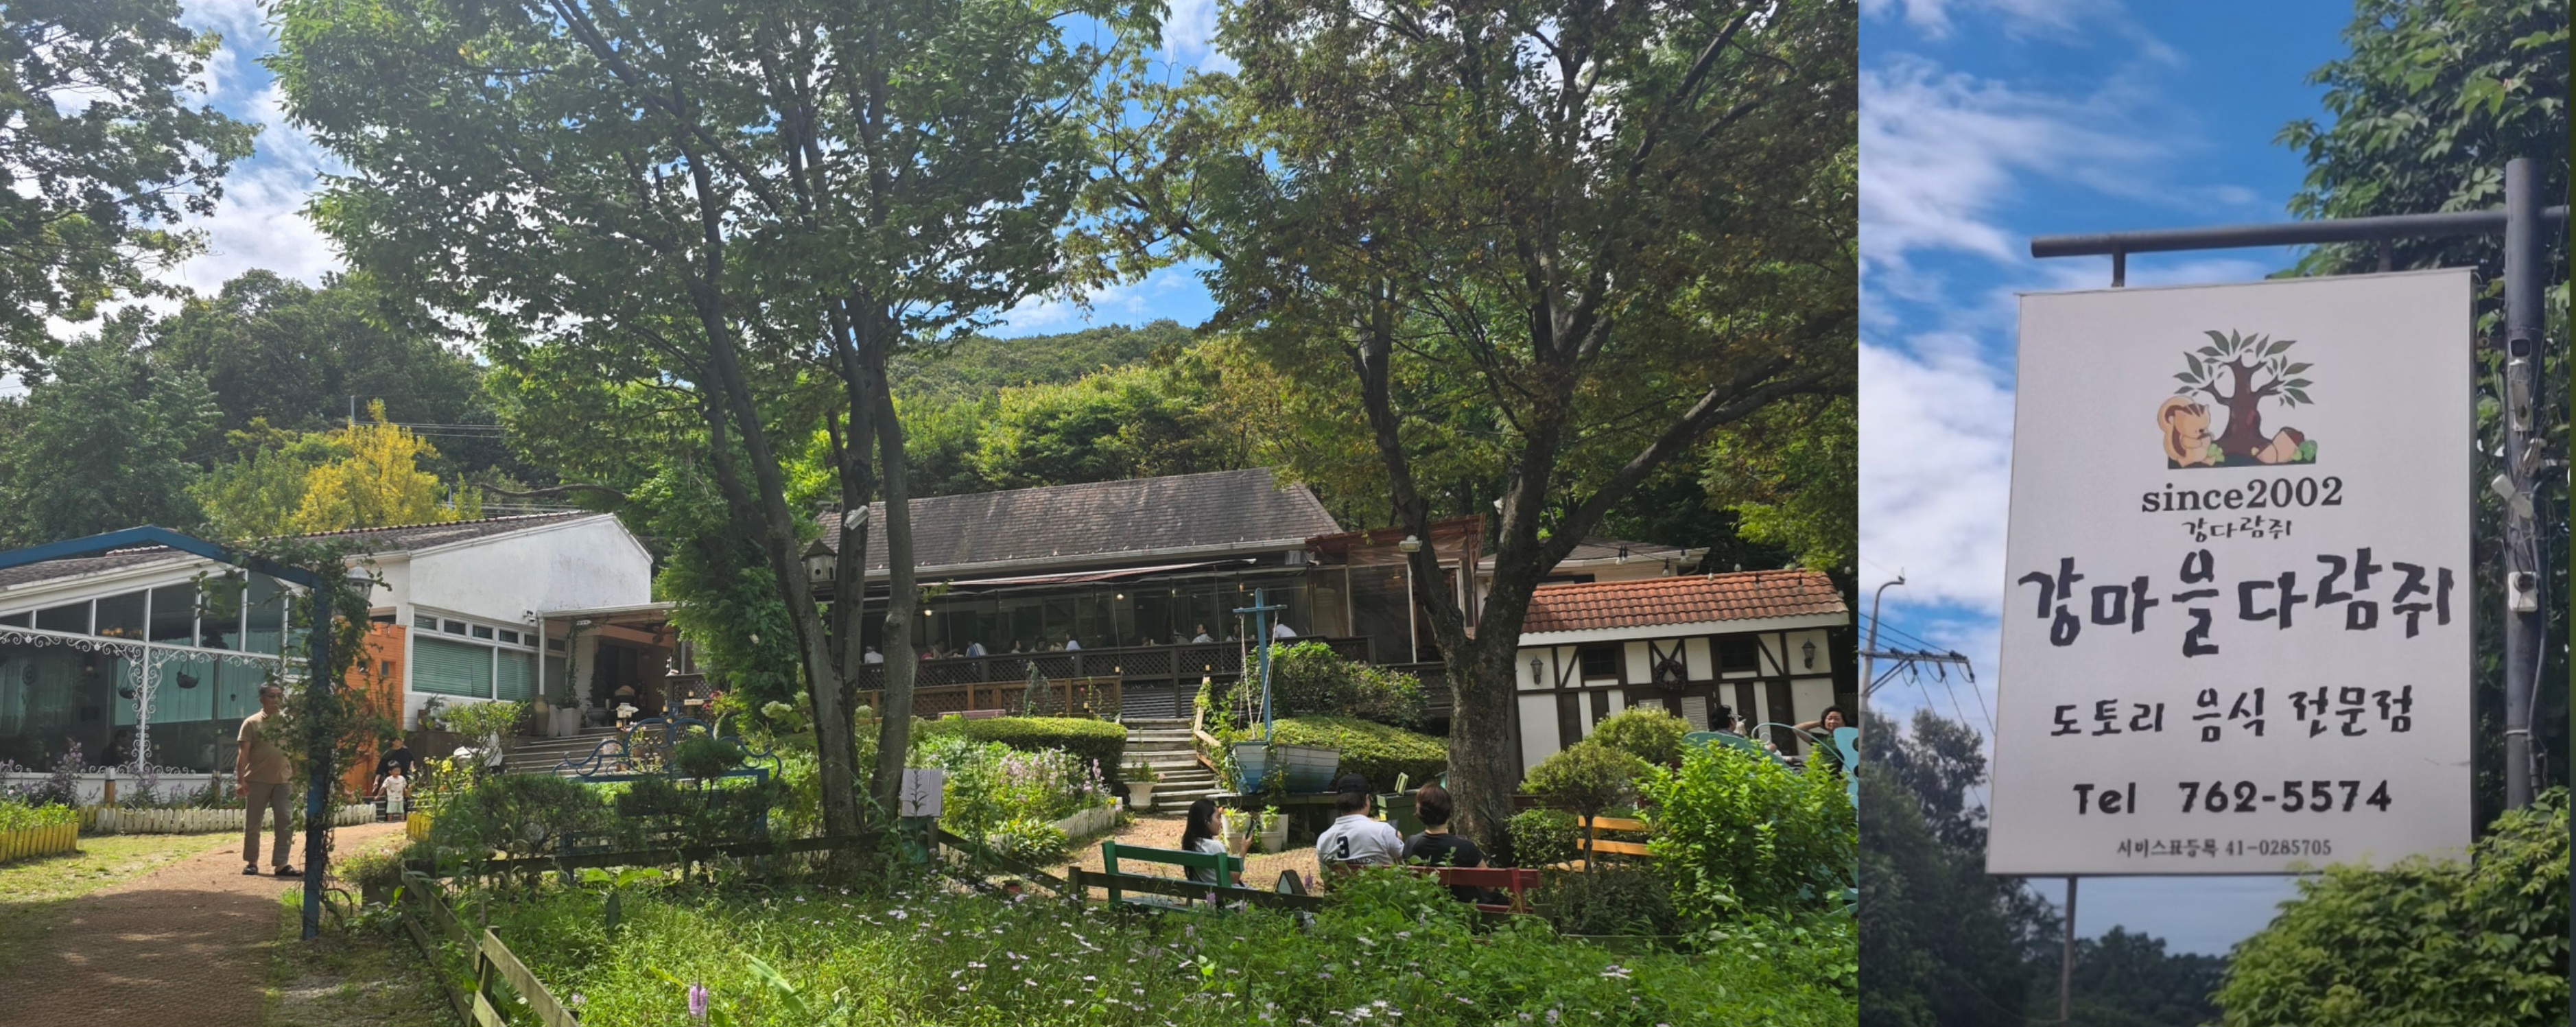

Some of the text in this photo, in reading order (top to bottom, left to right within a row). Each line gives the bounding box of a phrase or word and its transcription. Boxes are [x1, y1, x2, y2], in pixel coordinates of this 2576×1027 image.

[2142, 476, 2343, 512] since2002
[2182, 516, 2293, 543] 강다람쥐
[2018, 547, 2454, 658] 강마을다람쥐
[2050, 685, 2413, 743] 도토리 음식 전문점
[2072, 779, 2392, 815] Tel 762-5574
[1337, 836, 1350, 858] 3
[2117, 838, 2332, 858] 서비스표등록 41-0285705
